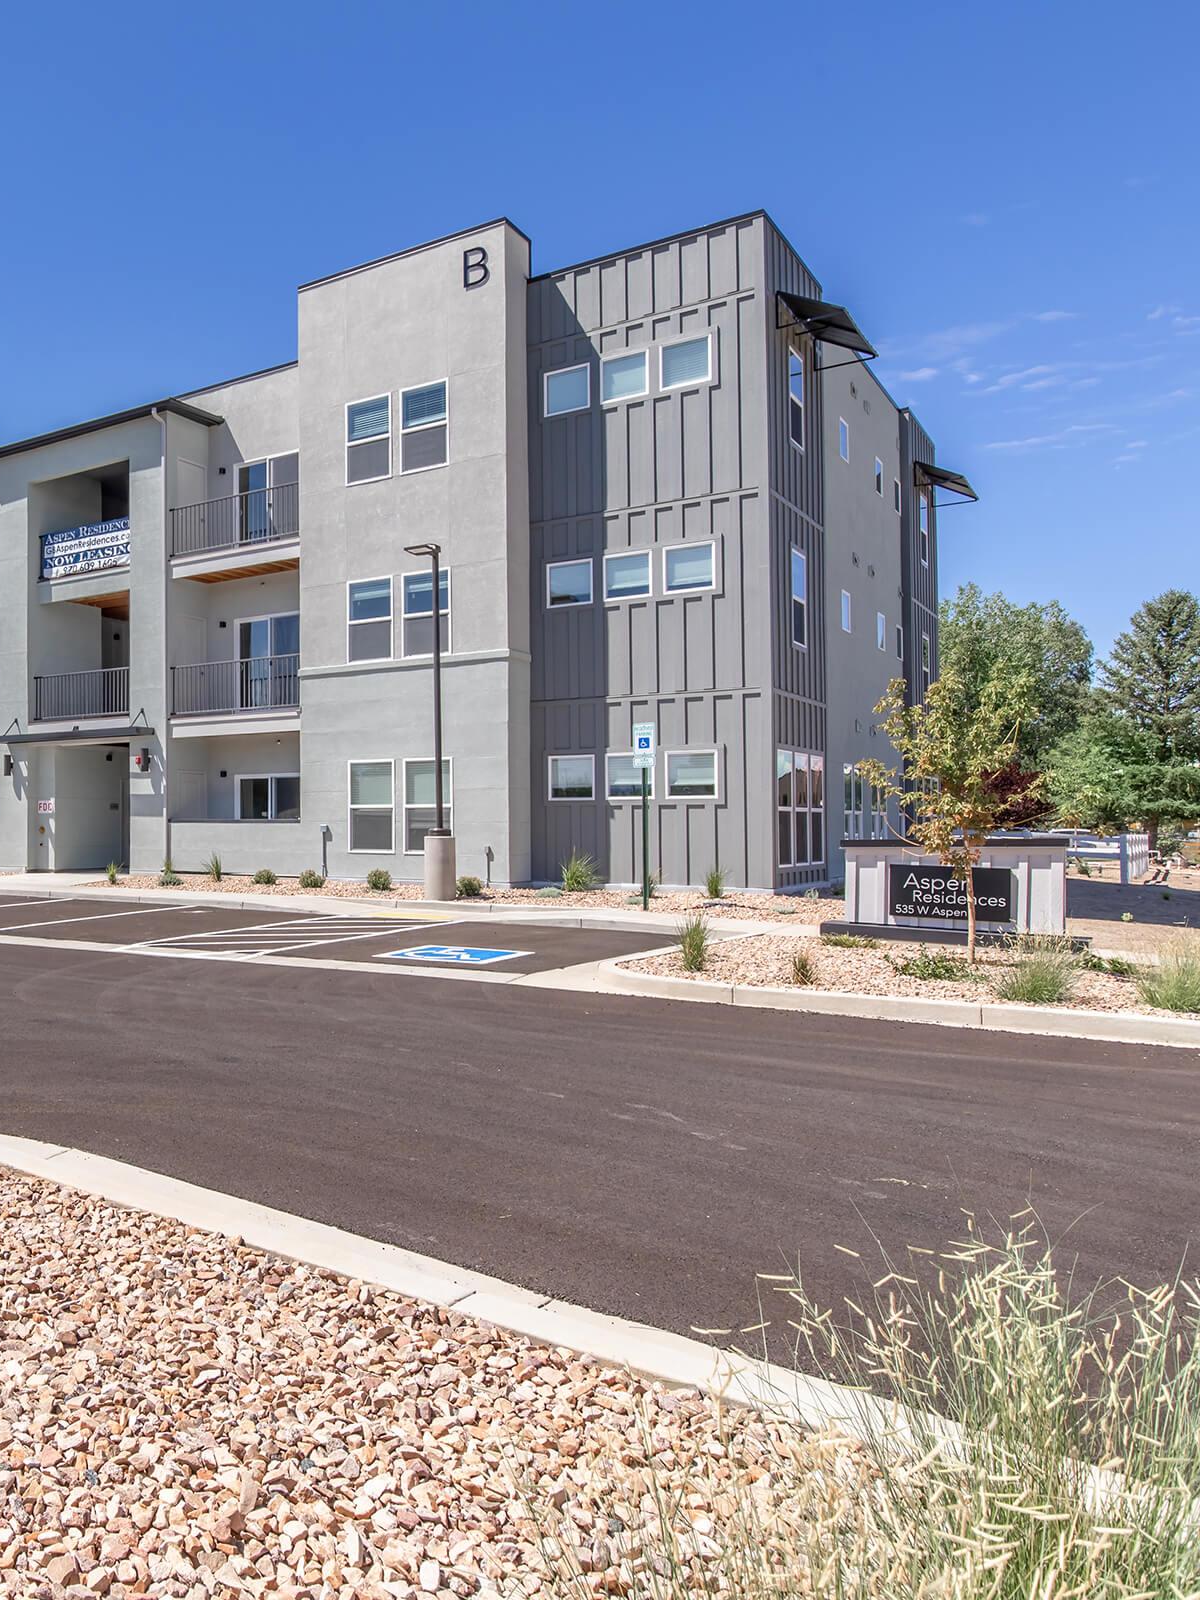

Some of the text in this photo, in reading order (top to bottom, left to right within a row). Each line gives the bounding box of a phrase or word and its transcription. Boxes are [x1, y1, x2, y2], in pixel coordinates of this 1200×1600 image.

[463, 246, 489, 289] B
[46, 554, 76, 568] NOW
[895, 903, 968, 918] 535 W Aspen
